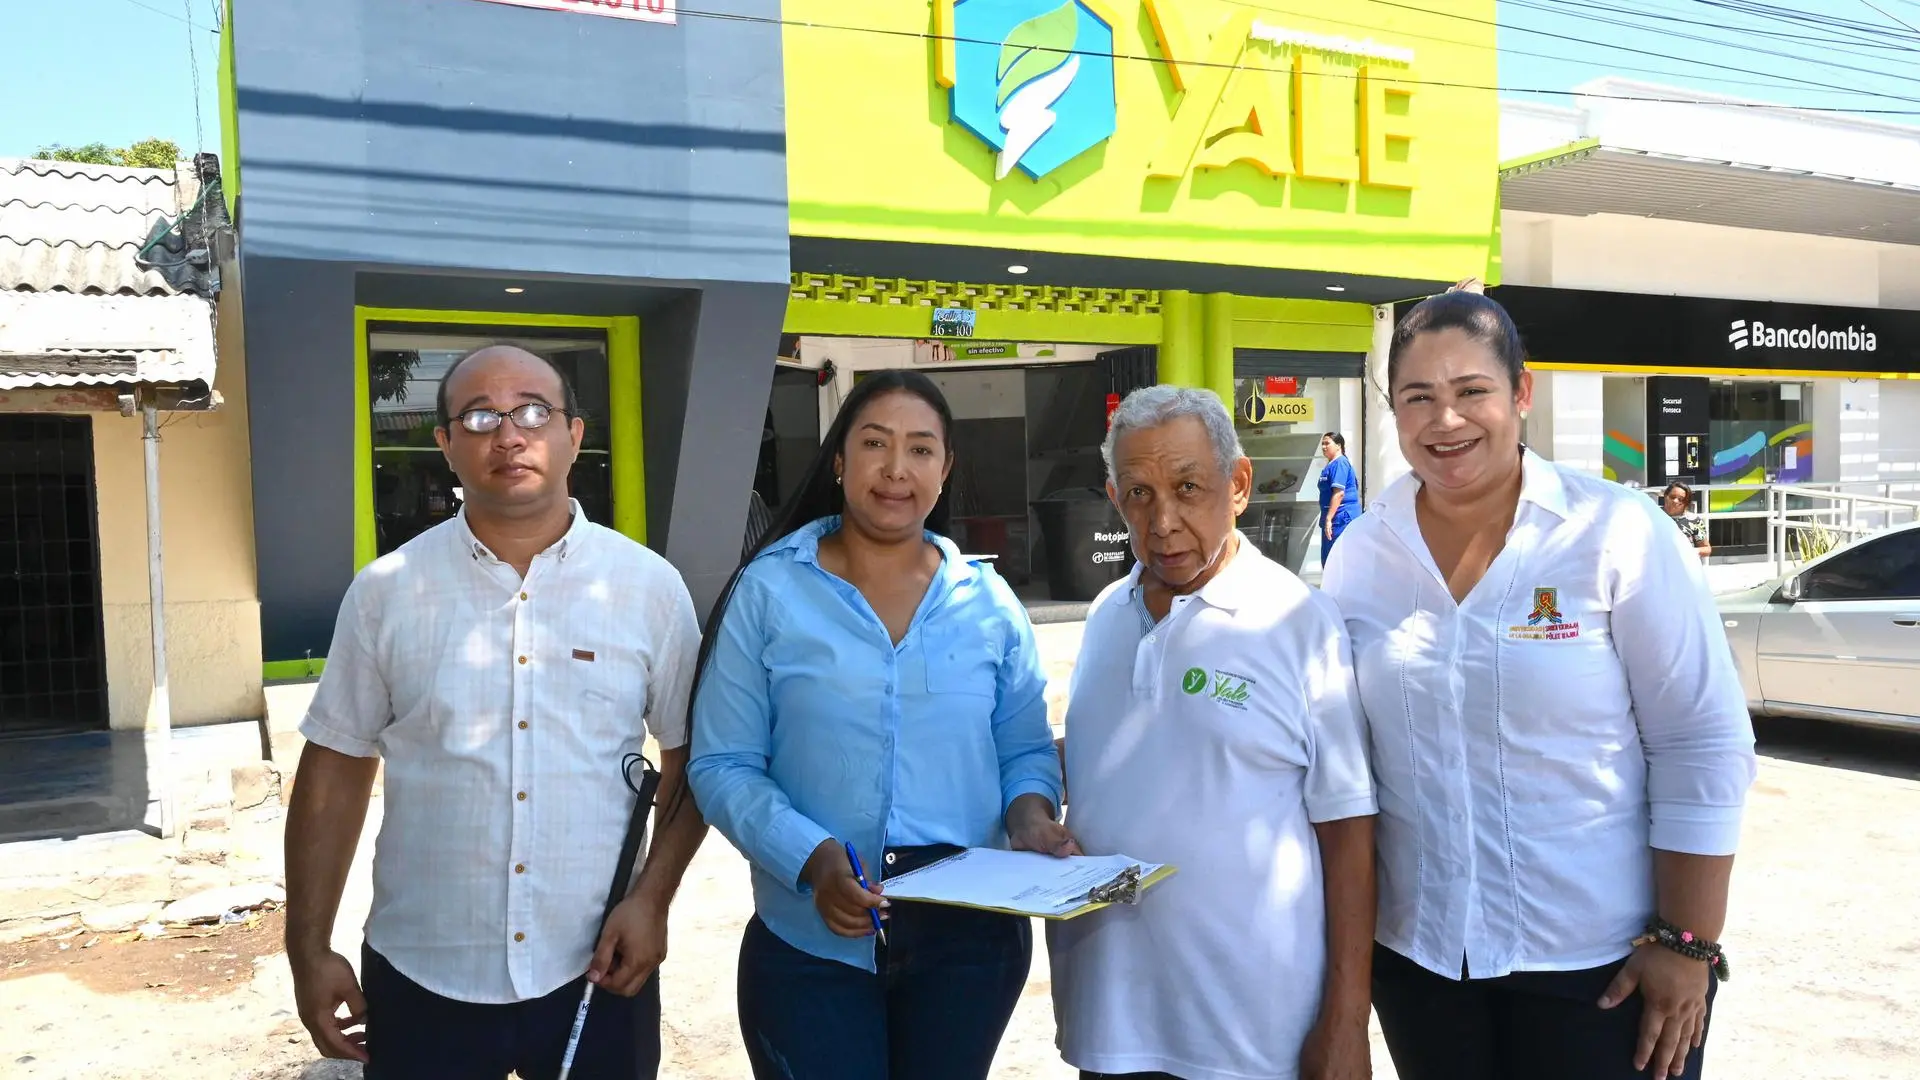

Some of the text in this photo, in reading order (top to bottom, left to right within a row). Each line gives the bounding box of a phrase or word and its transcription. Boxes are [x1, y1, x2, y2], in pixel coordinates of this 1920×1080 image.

[1140, 0, 1416, 190] YALE
[933, 324, 945, 336] 16
[956, 325, 972, 337] 100
[1752, 321, 1877, 351] Bancolombia
[1269, 404, 1307, 415] ARGOS
[1208, 672, 1250, 702] Yale
